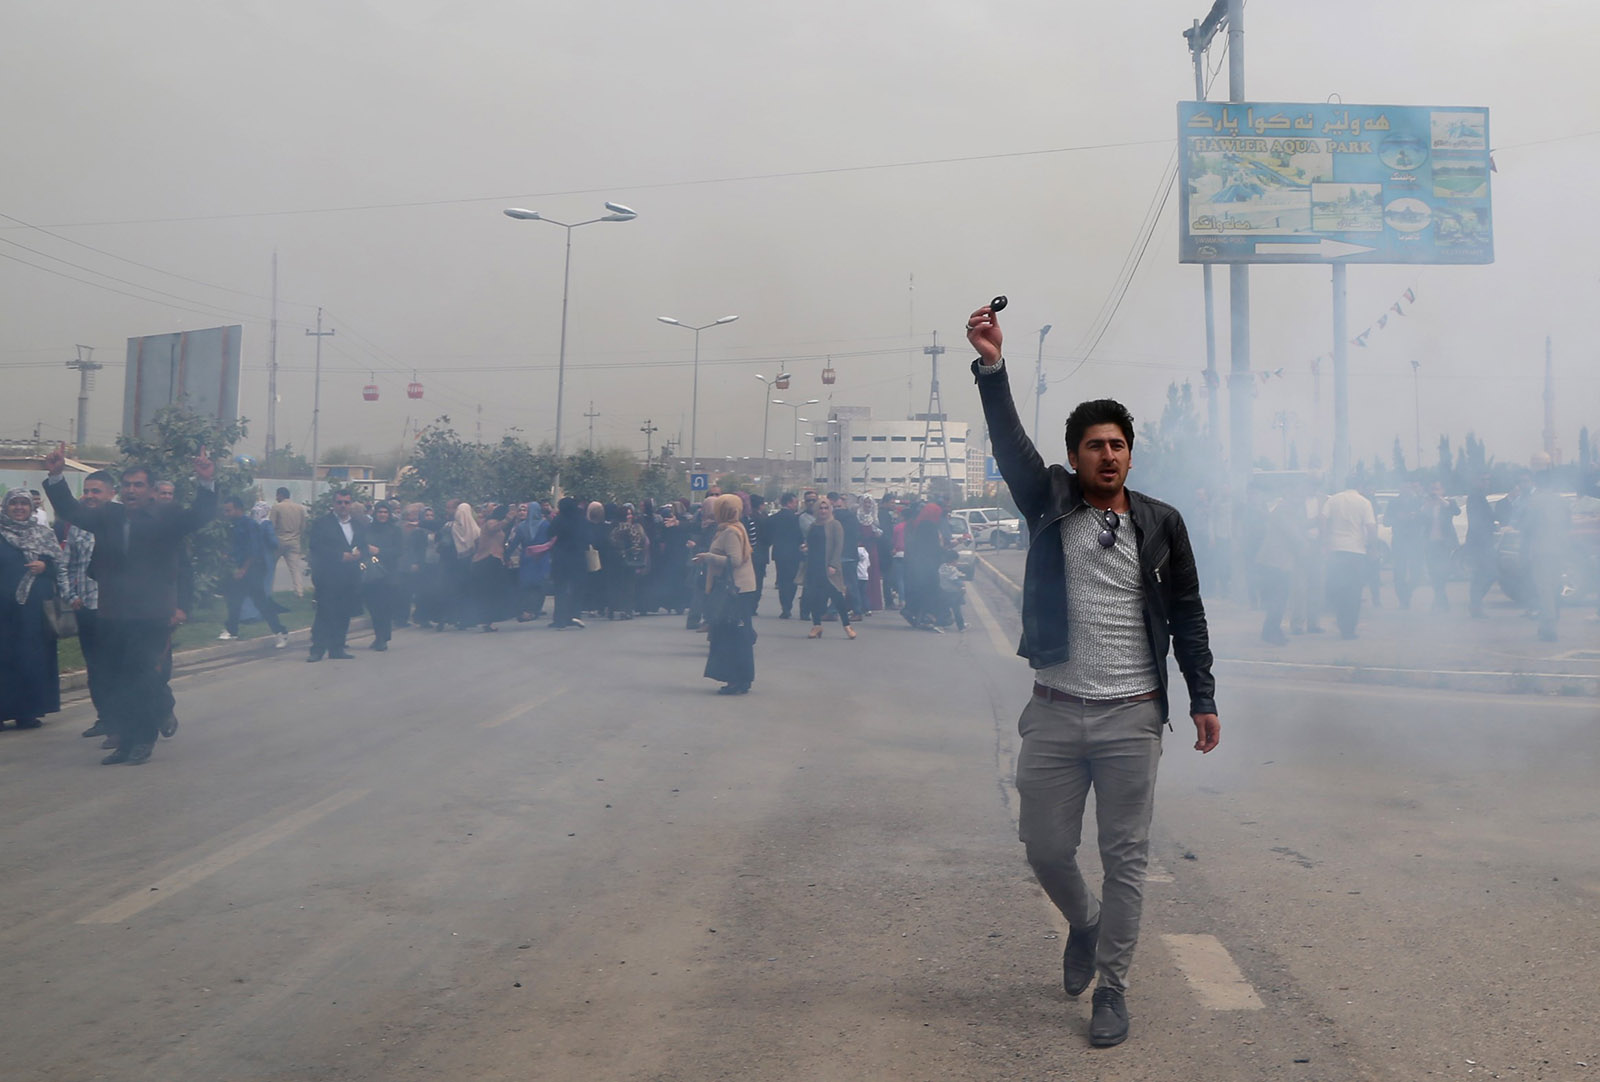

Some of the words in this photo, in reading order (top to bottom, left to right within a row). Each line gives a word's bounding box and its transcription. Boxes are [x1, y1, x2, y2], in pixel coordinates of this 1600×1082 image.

[1194, 138, 1267, 154] HAWLER
[1271, 139, 1320, 155] AQUA
[1326, 139, 1373, 154] PARK
